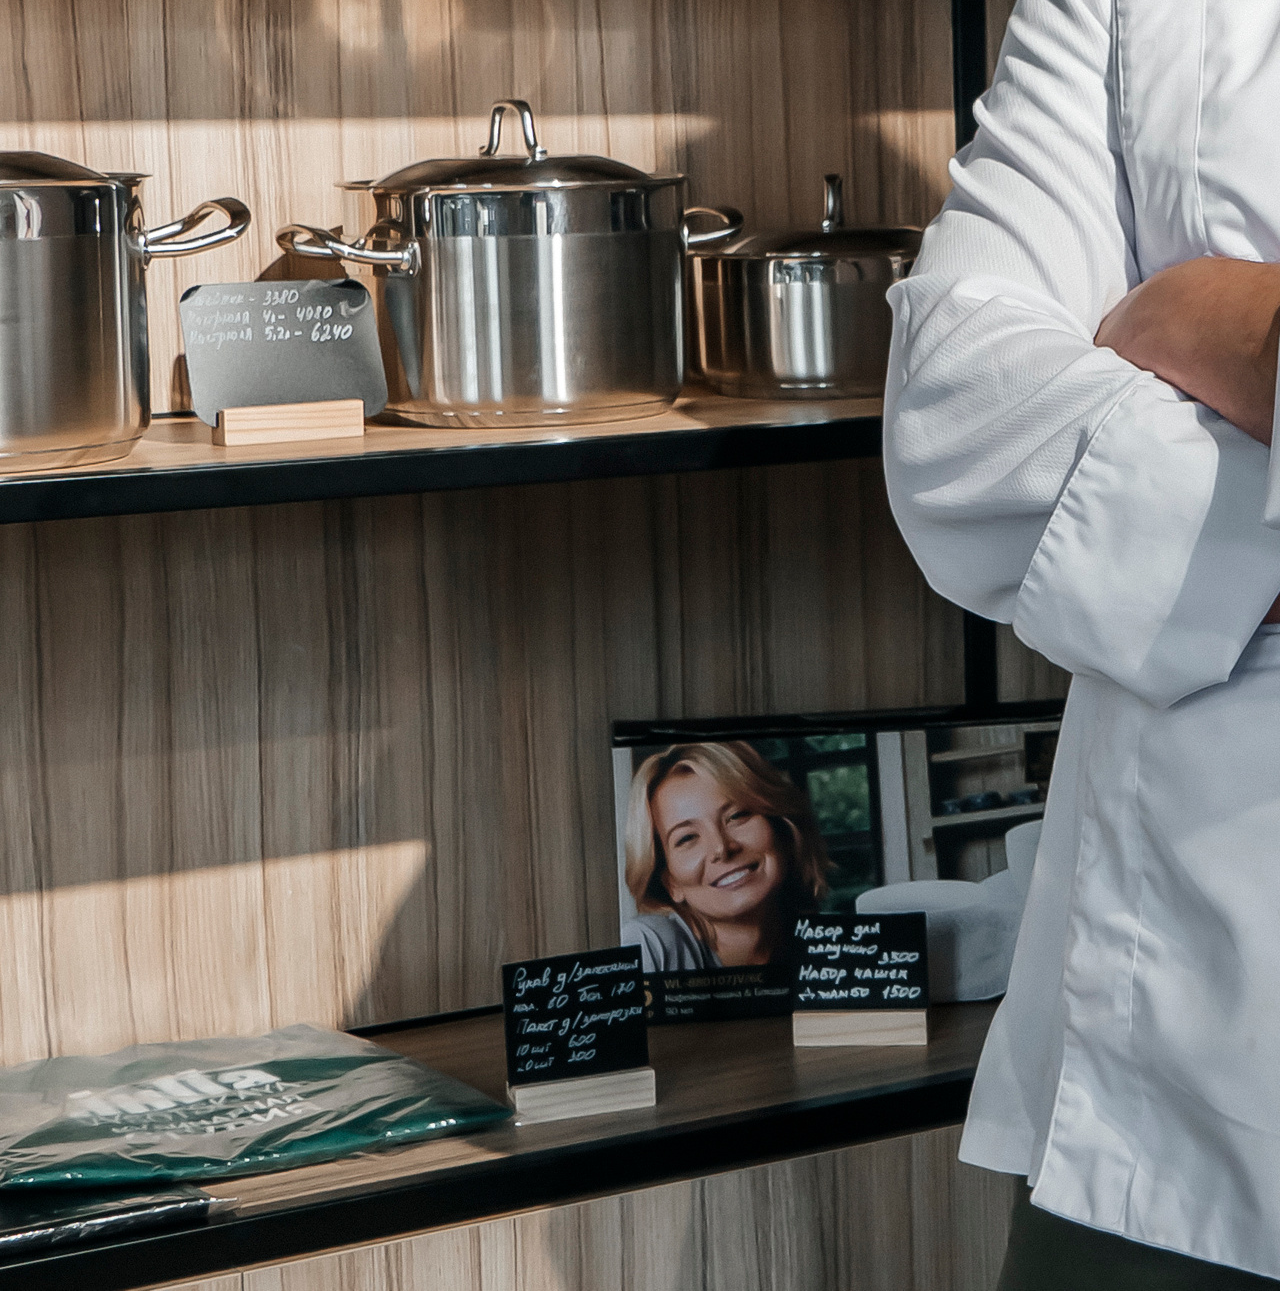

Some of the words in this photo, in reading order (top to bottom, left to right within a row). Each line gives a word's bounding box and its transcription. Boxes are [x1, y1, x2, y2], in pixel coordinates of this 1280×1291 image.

[262, 289, 299, 306] 3380
[311, 323, 353, 342] 6240
[795, 918, 843, 942] Набор
[851, 922, 880, 941] для
[513, 966, 551, 997] Рукав
[799, 964, 848, 985] Набор
[853, 967, 908, 980] чашек
[882, 984, 921, 1000] 1500
[516, 1018, 559, 1035] Пакет
